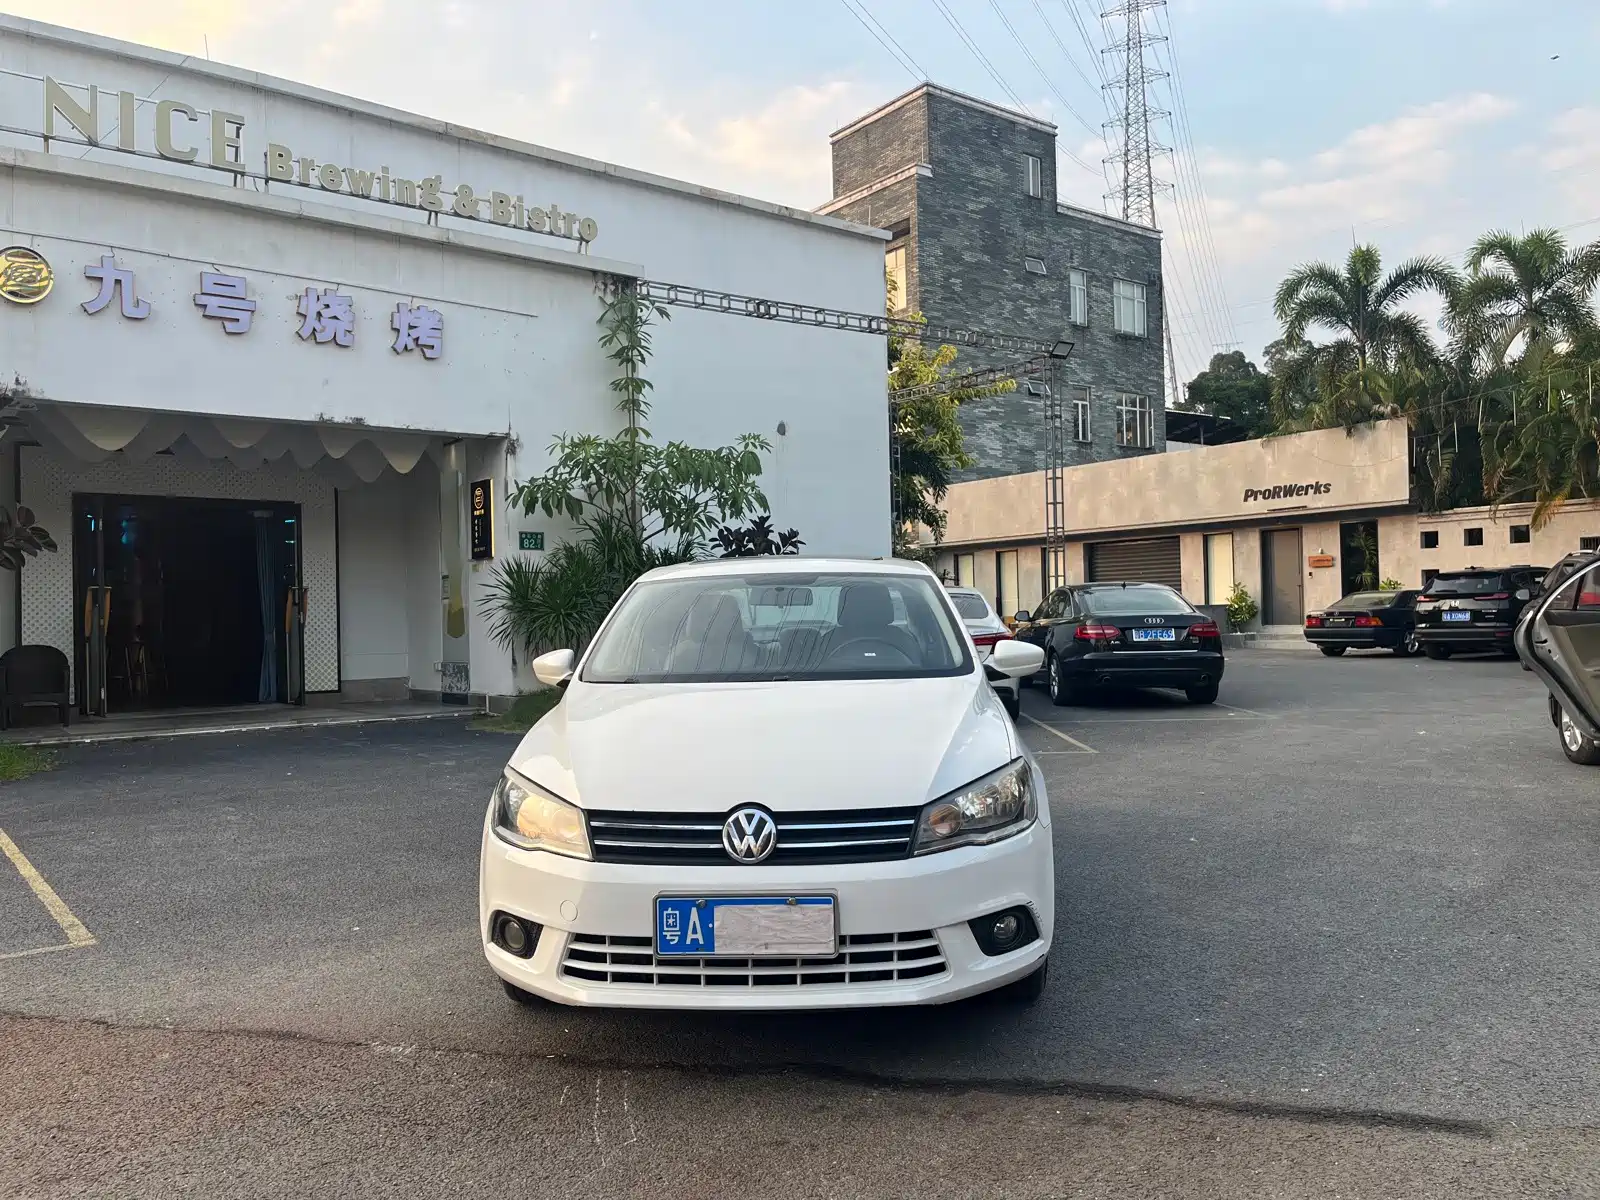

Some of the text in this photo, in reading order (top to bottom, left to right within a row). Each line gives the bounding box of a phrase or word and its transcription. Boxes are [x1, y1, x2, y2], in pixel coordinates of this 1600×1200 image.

[43, 75, 598, 243] NICE Brewing & Bistro
[81, 254, 445, 361] 九号烧烤
[1243, 481, 1332, 503] ProRWerks
